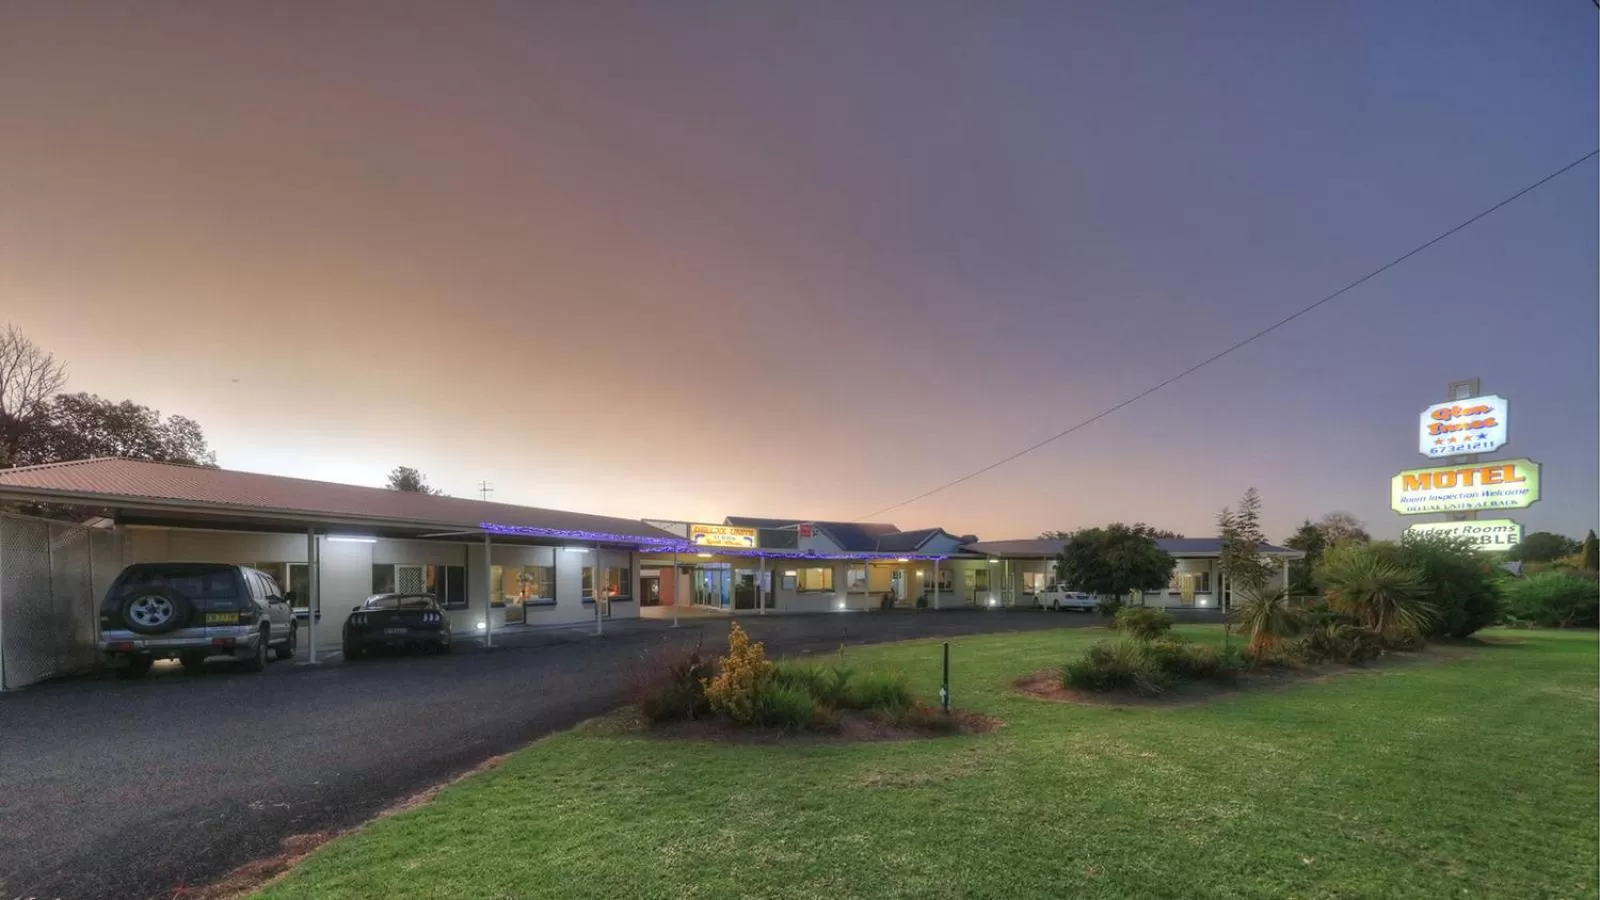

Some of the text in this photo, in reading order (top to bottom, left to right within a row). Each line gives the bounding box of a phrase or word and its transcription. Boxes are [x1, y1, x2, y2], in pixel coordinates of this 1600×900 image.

[1430, 441, 1494, 454] 67321211
[1402, 464, 1526, 492] MOTEL
[1400, 488, 1530, 503] Room Inspection Welcome
[1407, 524, 1516, 537] Budget Rooms
